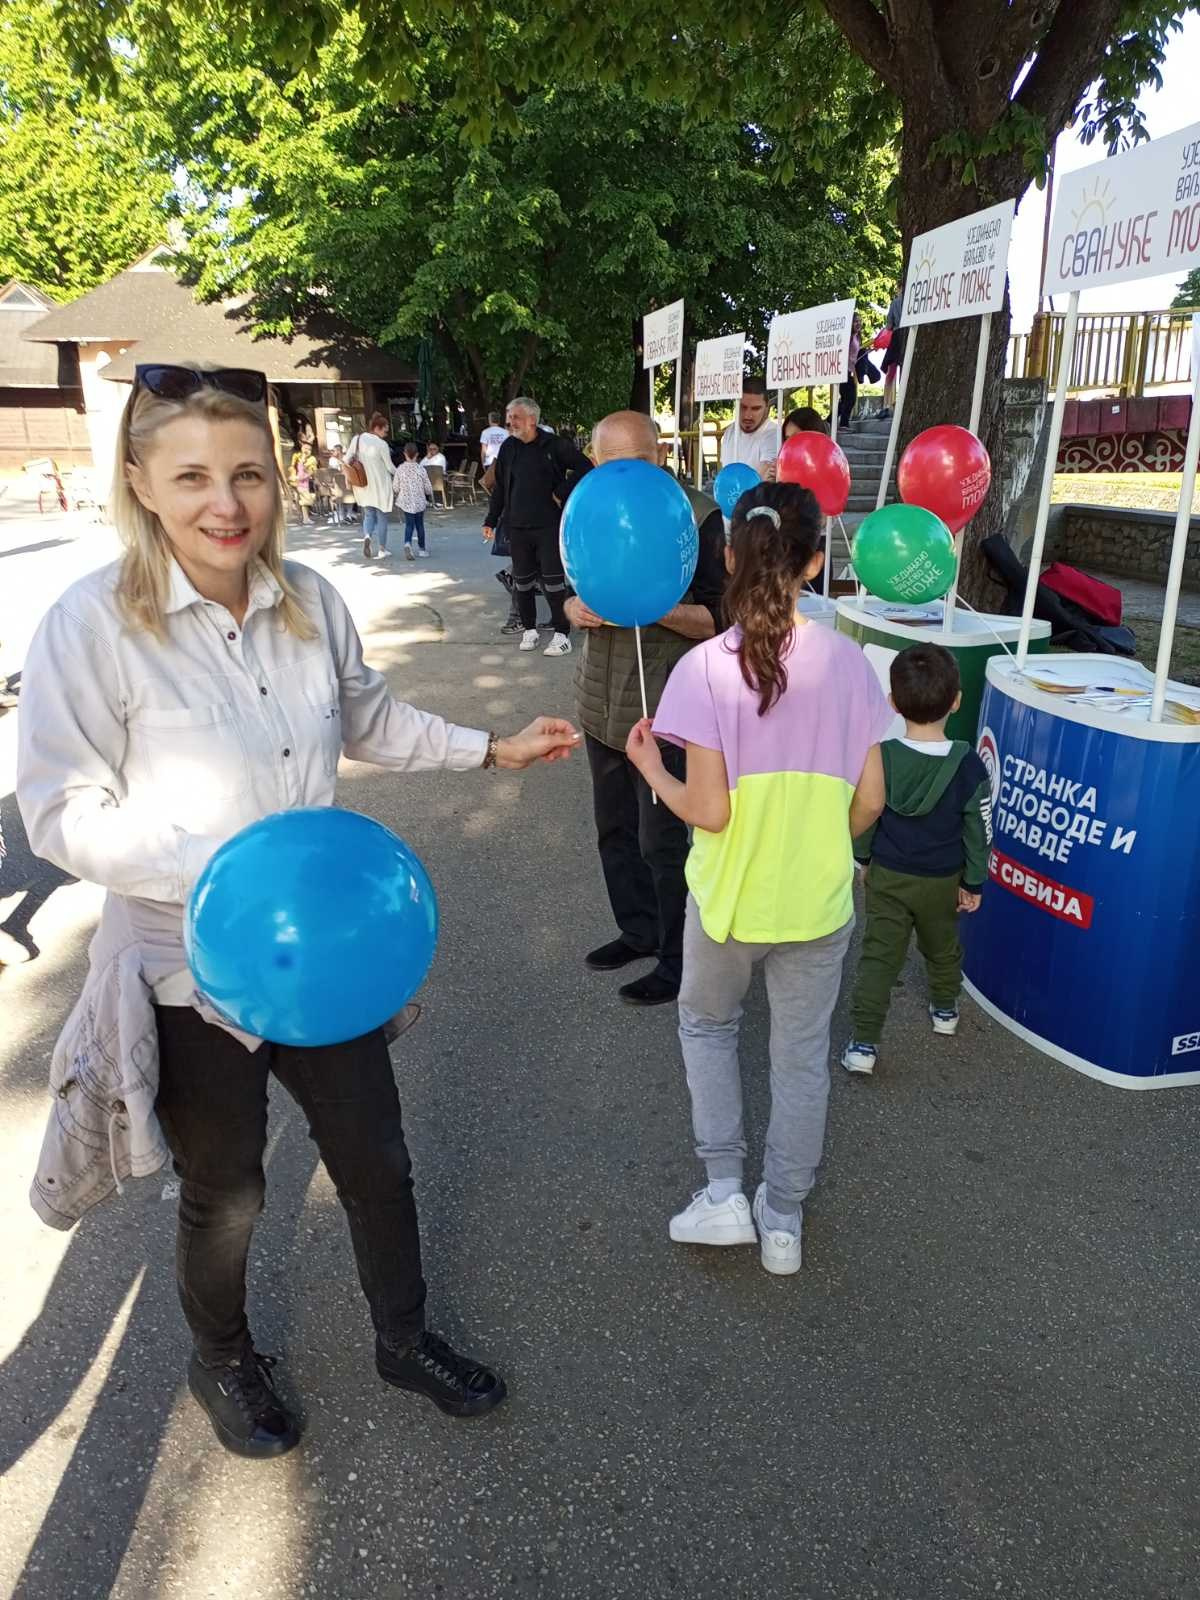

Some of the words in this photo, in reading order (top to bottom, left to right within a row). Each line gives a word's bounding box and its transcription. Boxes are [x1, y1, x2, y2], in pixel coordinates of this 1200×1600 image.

[958, 264, 995, 306] МОЖЕ
[815, 349, 843, 377] МОЖЕ
[901, 563, 945, 600] МОЖЕ
[1003, 754, 1098, 813] СТРАНКА
[996, 807, 1074, 864] ПРАВДЕ
[999, 782, 1108, 845] СЛОБОДЕ
[1110, 826, 1137, 855] И
[1001, 862, 1083, 921] СРБИЈА
[1176, 1034, 1200, 1051] SS
